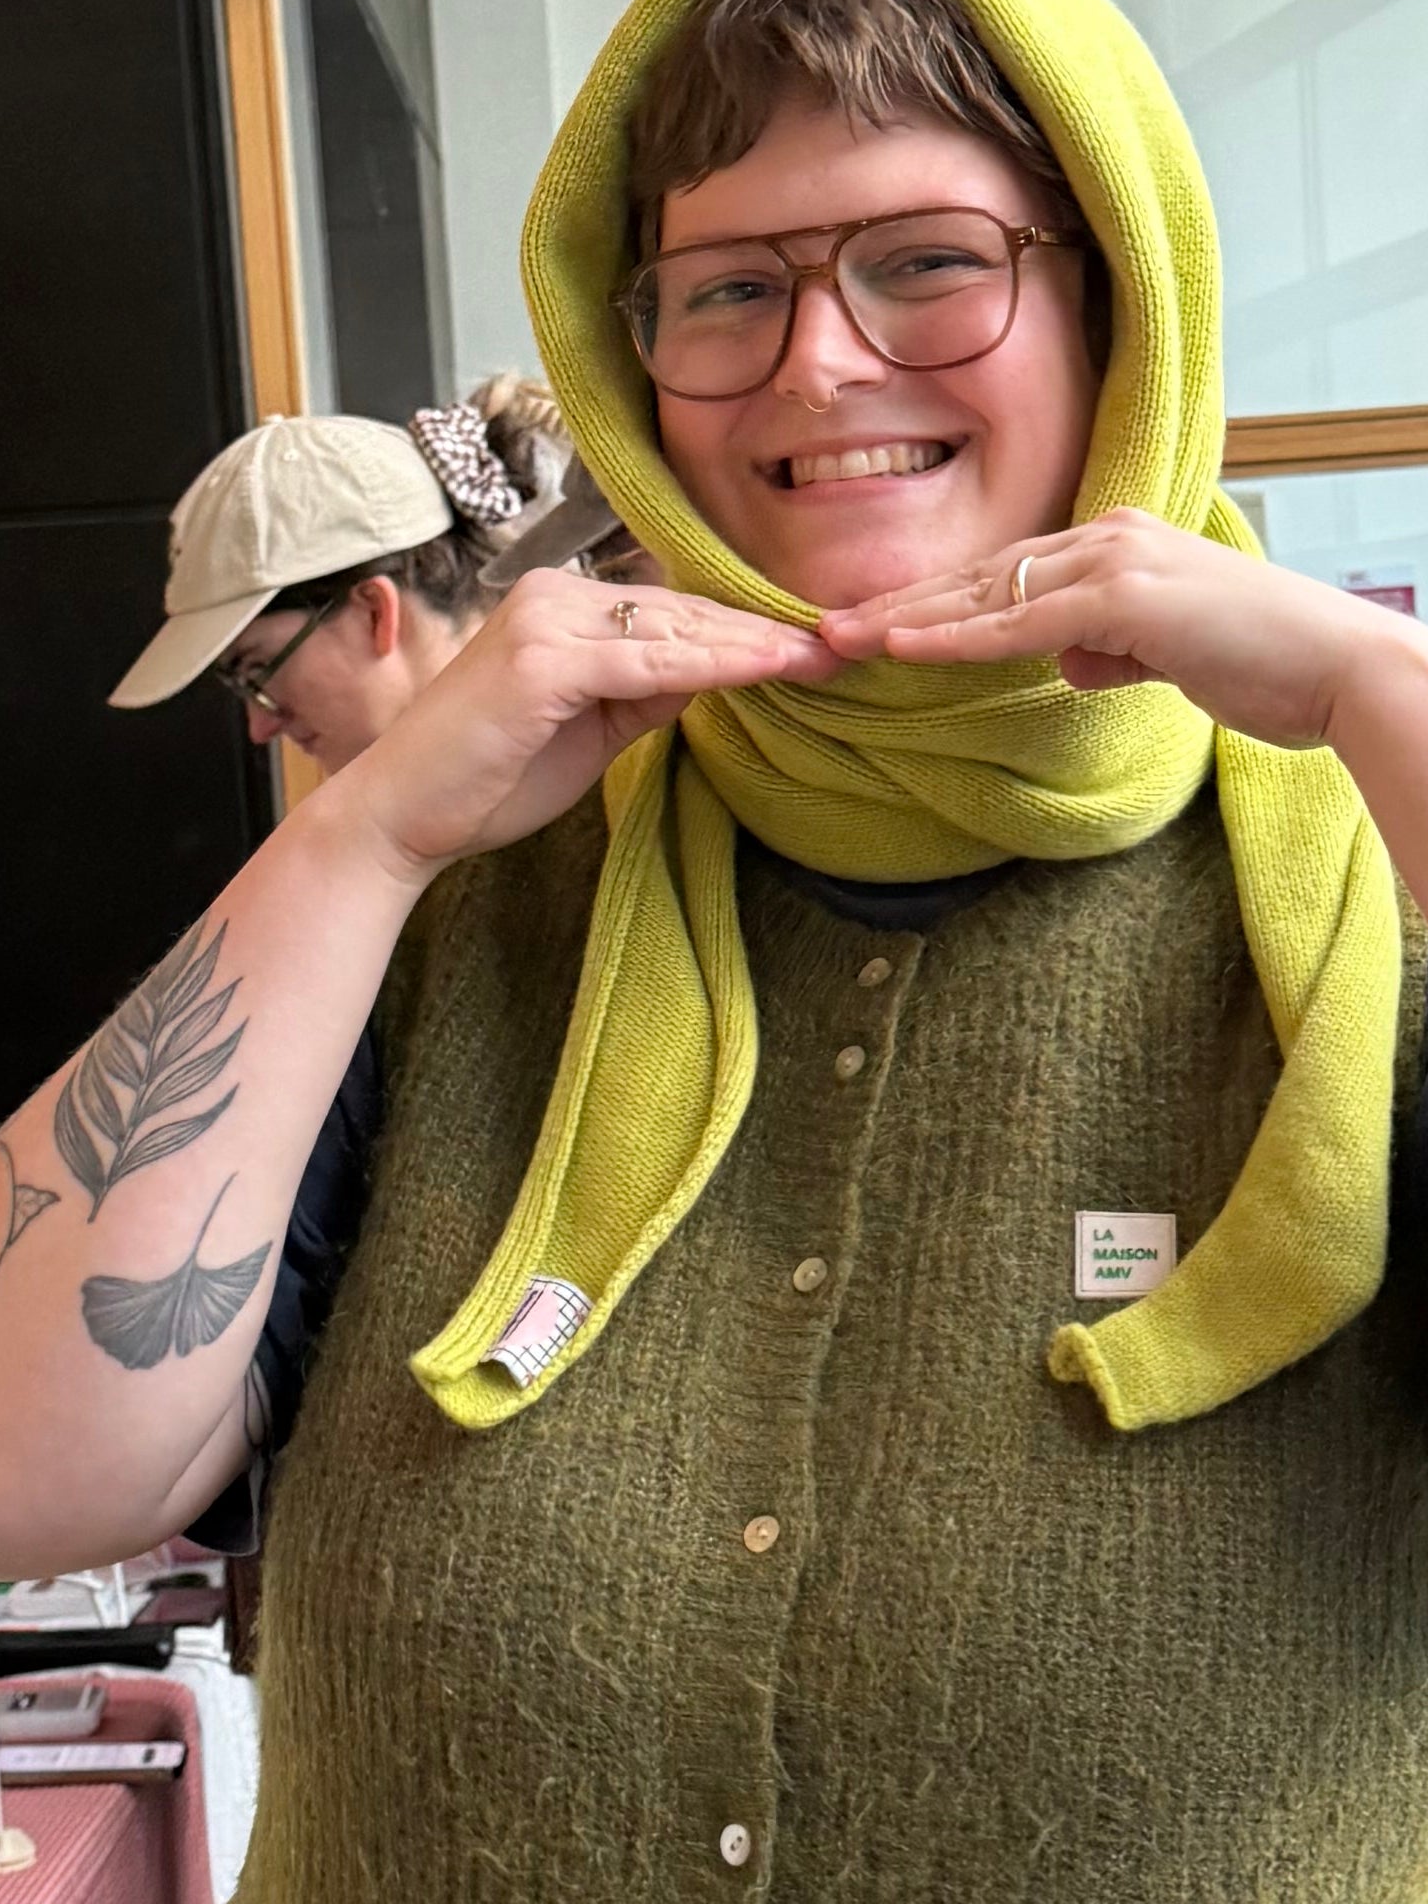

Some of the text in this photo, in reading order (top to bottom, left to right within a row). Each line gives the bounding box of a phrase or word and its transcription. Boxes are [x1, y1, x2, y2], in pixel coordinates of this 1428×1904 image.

[1093, 1228, 1114, 1242] LA
[1093, 1247, 1158, 1261] MAISON
[1094, 1266, 1133, 1280] AMV
